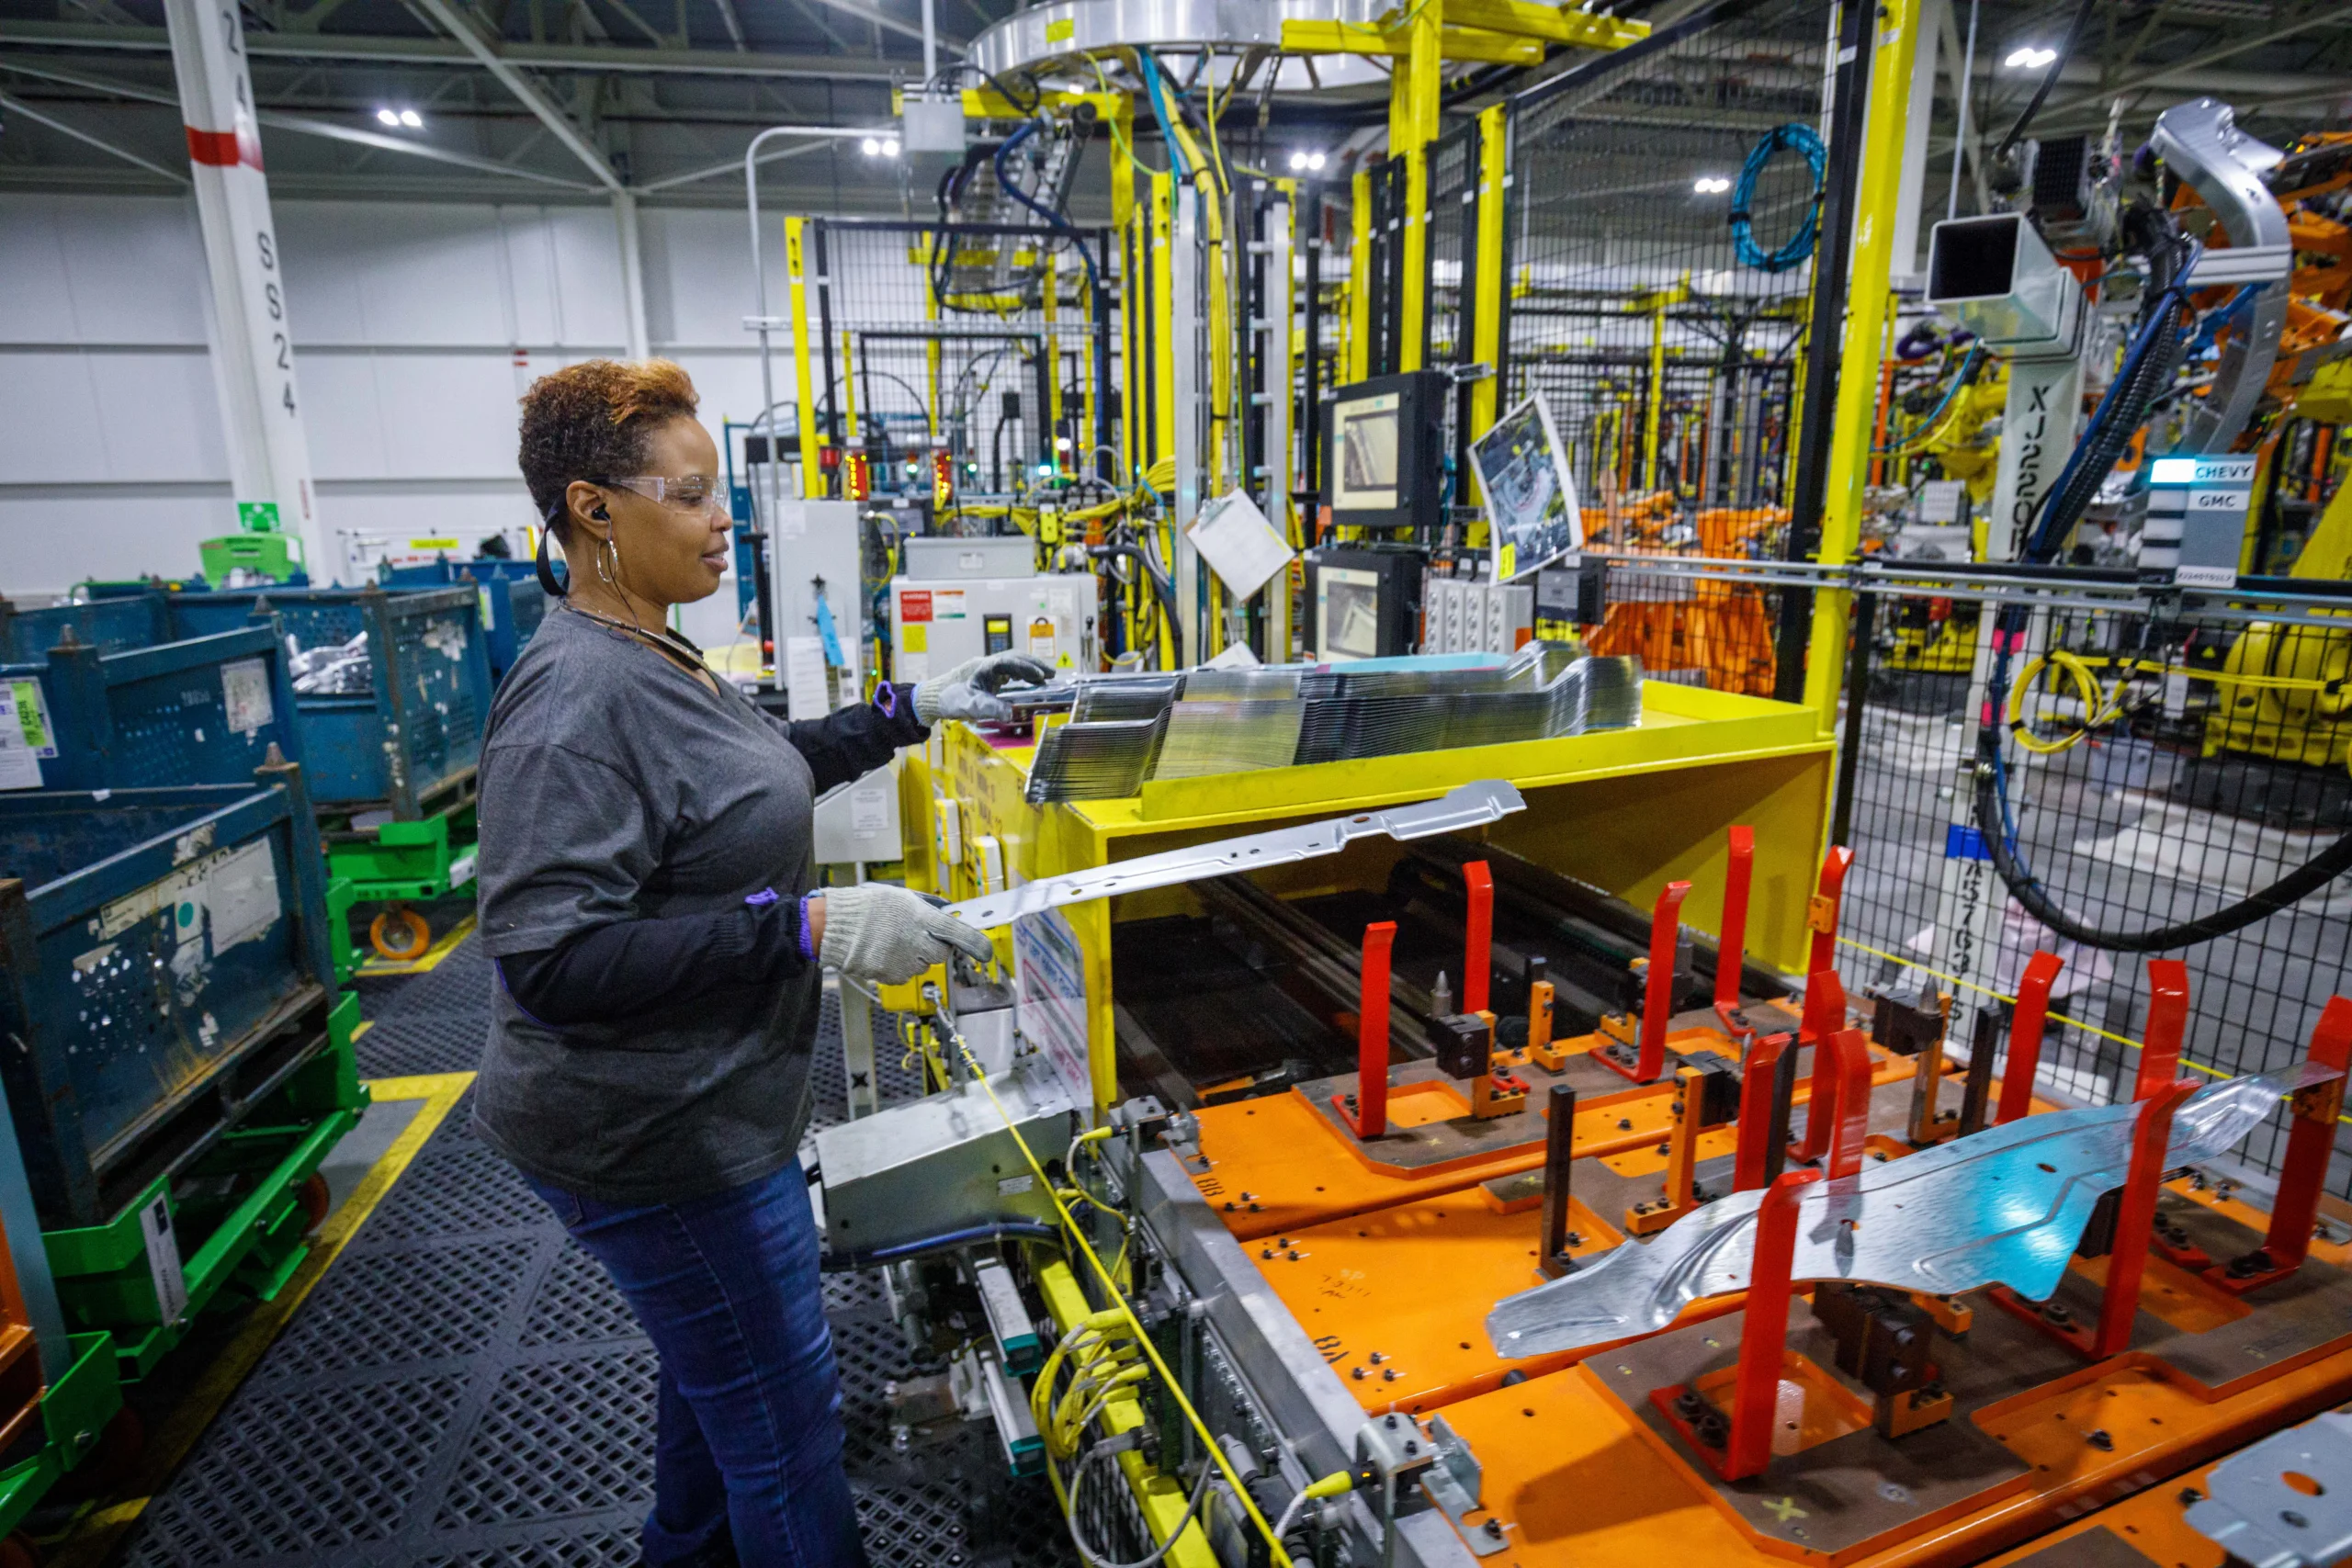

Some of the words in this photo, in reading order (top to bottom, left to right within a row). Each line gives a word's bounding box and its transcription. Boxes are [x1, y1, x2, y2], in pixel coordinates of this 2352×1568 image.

[256, 231, 296, 418] SS24
[2195, 465, 2253, 479] CHEVY
[2198, 494, 2237, 508] GMC
